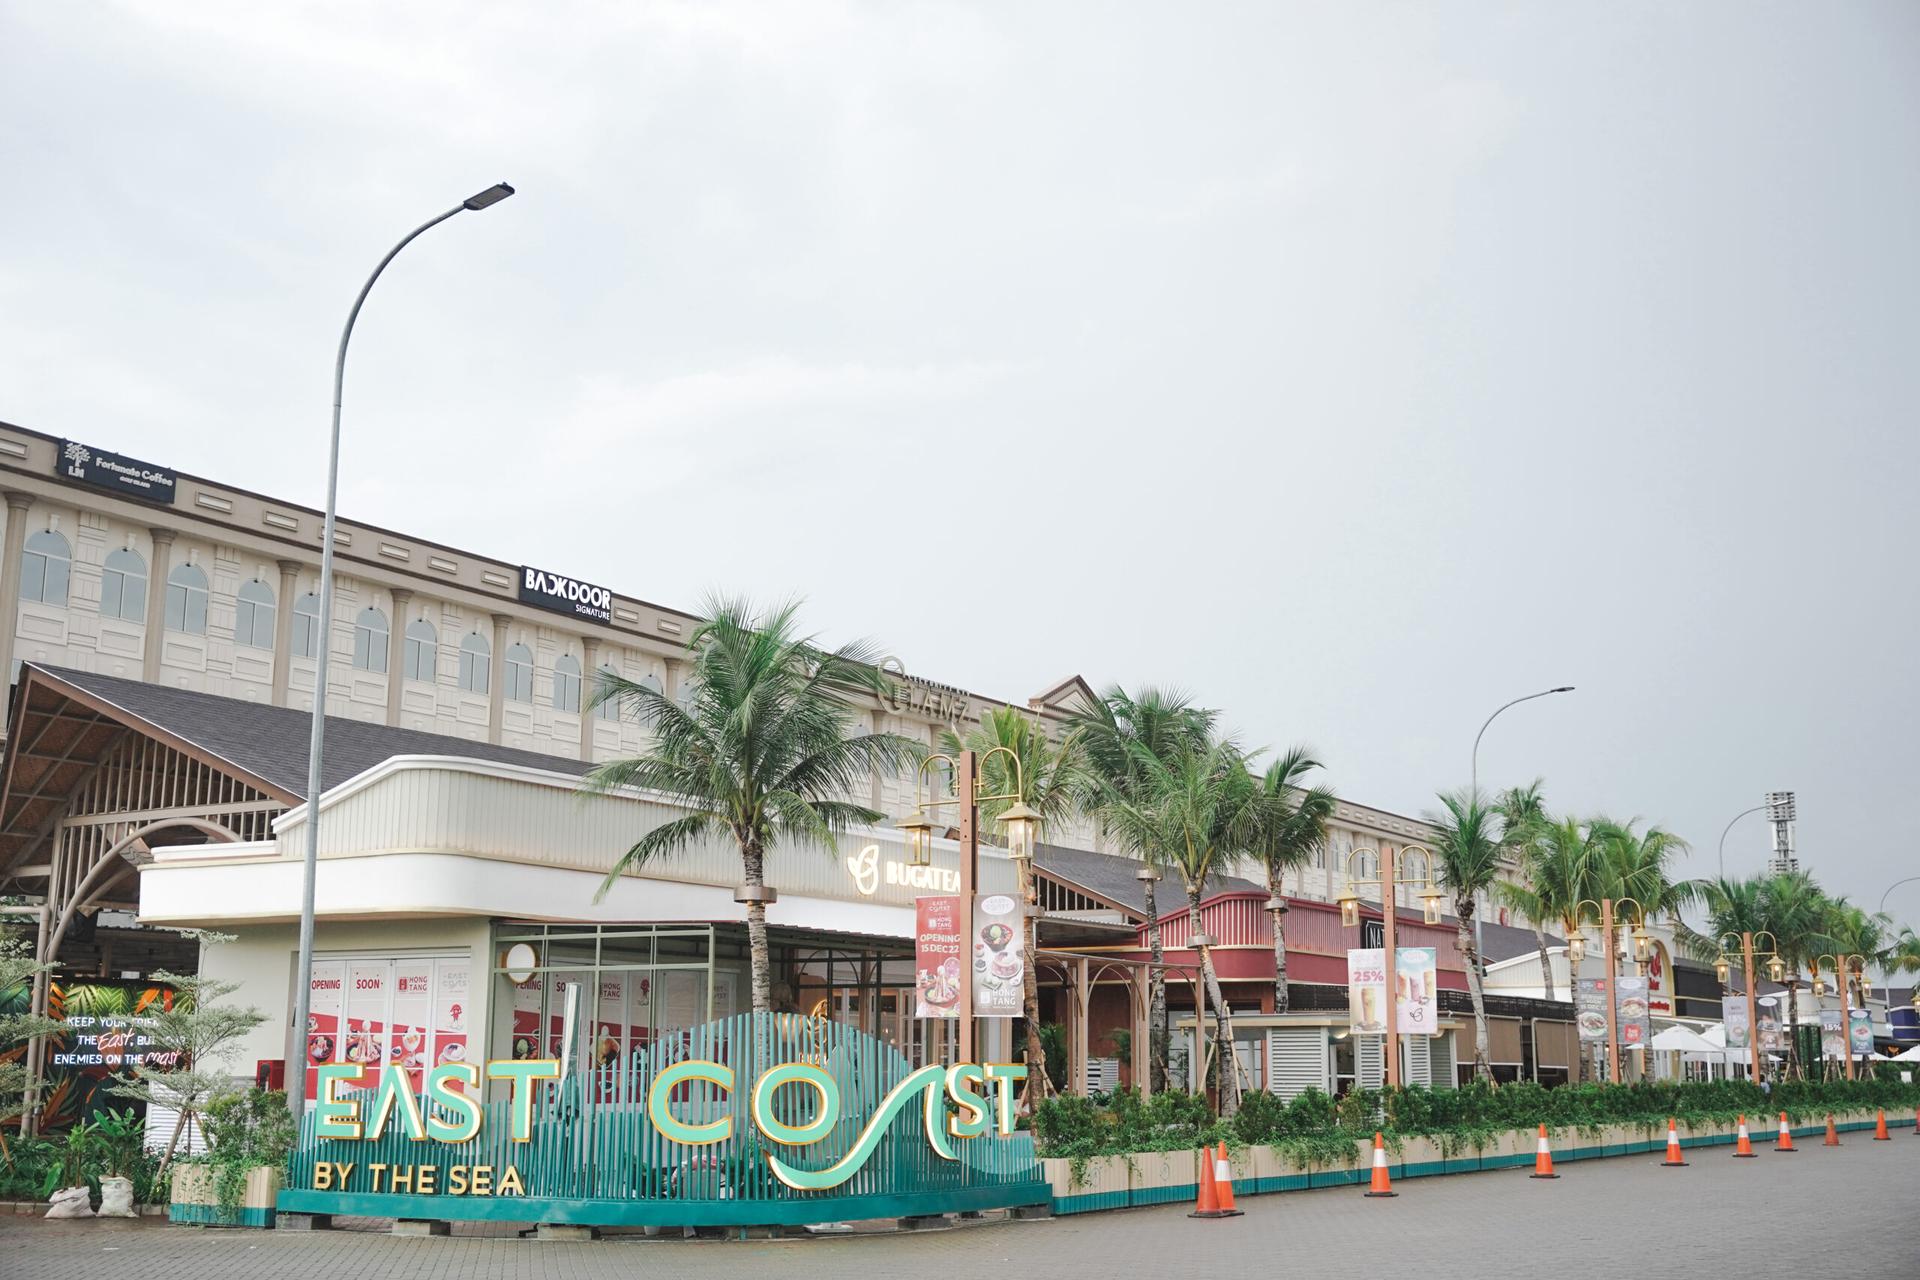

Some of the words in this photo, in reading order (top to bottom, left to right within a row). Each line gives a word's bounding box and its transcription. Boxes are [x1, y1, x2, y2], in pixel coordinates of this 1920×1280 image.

[141, 470, 173, 487] Coffee
[525, 568, 611, 610] BACKDOOR
[575, 604, 610, 620] SIGNATURE
[920, 934, 960, 943] OPENING
[409, 975, 428, 983] HONG
[1353, 970, 1384, 982] 25%
[311, 979, 341, 990] OPENING
[356, 979, 380, 990] SOON
[993, 997, 1015, 1005] TANG
[68, 1017, 95, 1027] KEEP
[78, 1035, 97, 1046] THE
[54, 1054, 103, 1065] ENEMIES
[106, 1054, 121, 1064] ON
[125, 1054, 144, 1064] THE
[316, 1059, 561, 1143] EAST
[648, 1060, 1028, 1191] COAST
[313, 1161, 356, 1191] BY
[368, 1163, 435, 1195] THE
[448, 1165, 526, 1196] SEA
